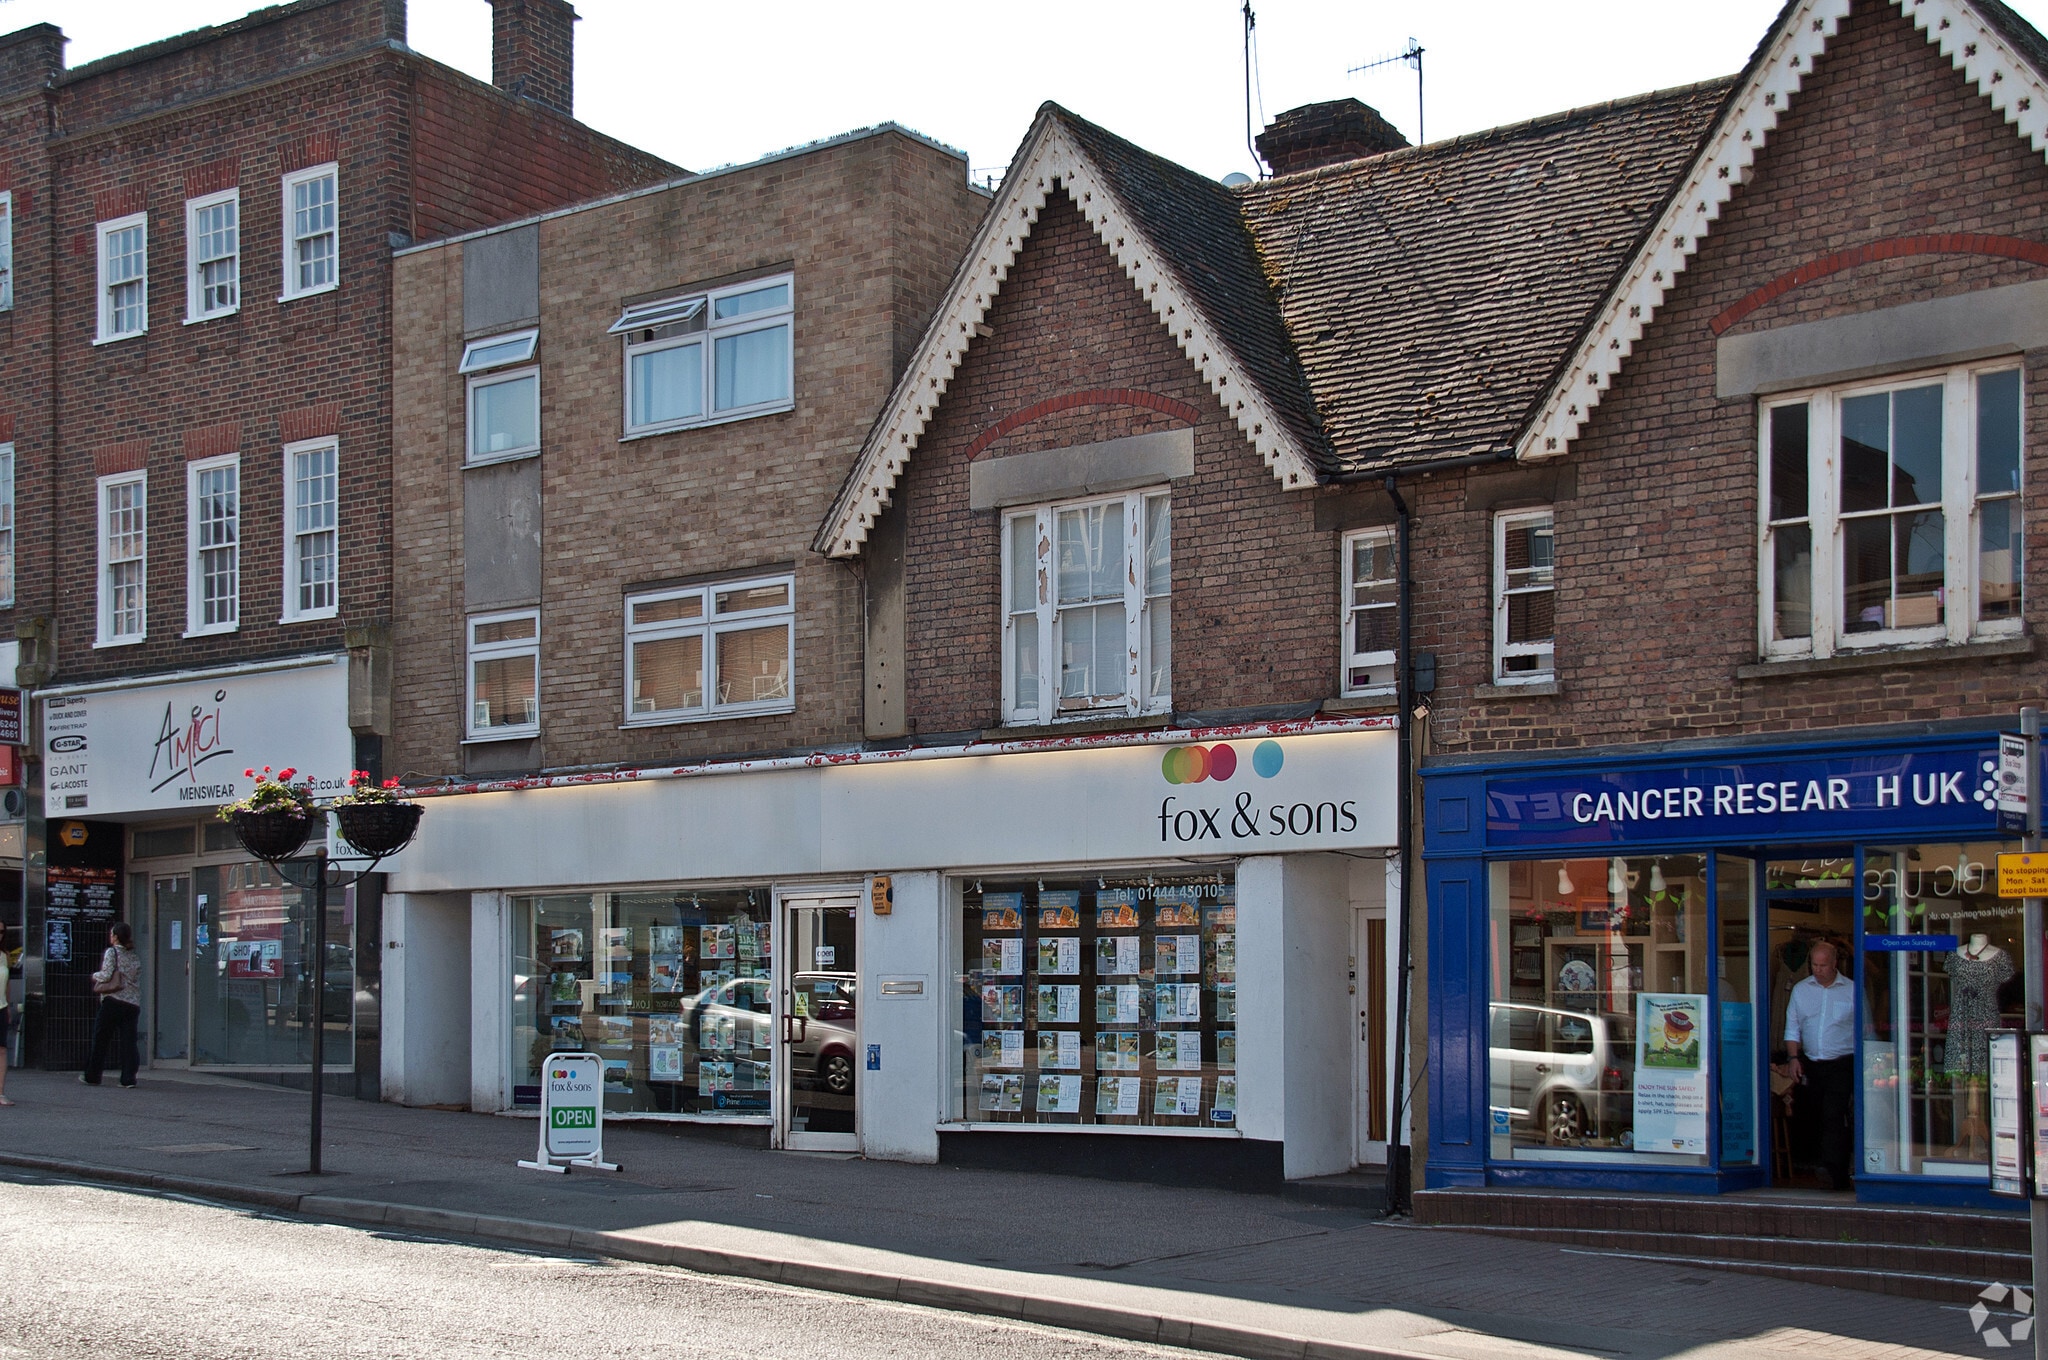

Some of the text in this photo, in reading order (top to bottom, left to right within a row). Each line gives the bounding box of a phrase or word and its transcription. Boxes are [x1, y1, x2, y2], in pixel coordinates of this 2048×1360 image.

[0, 695, 20, 705] use
[56, 740, 81, 748] G-STAR
[50, 763, 88, 777] GANT
[61, 780, 88, 789] LACOSTE
[179, 783, 236, 801] MENSWEAR
[1571, 784, 1703, 824] CANCER
[1912, 771, 1965, 806] UK
[1157, 791, 1358, 842] fox & sons
[335, 841, 354, 856] fox
[2016, 867, 2048, 875] stopping
[2031, 876, 2046, 884] Sat
[1113, 886, 1135, 902] Tel:
[1138, 885, 1176, 901] 01444
[1180, 884, 1226, 900] 450105
[2000, 887, 2027, 895] except
[1881, 938, 1900, 947] Open
[1911, 938, 1936, 948] Sundays
[551, 1080, 592, 1092] fox & sons
[555, 1109, 592, 1126] OPEN
